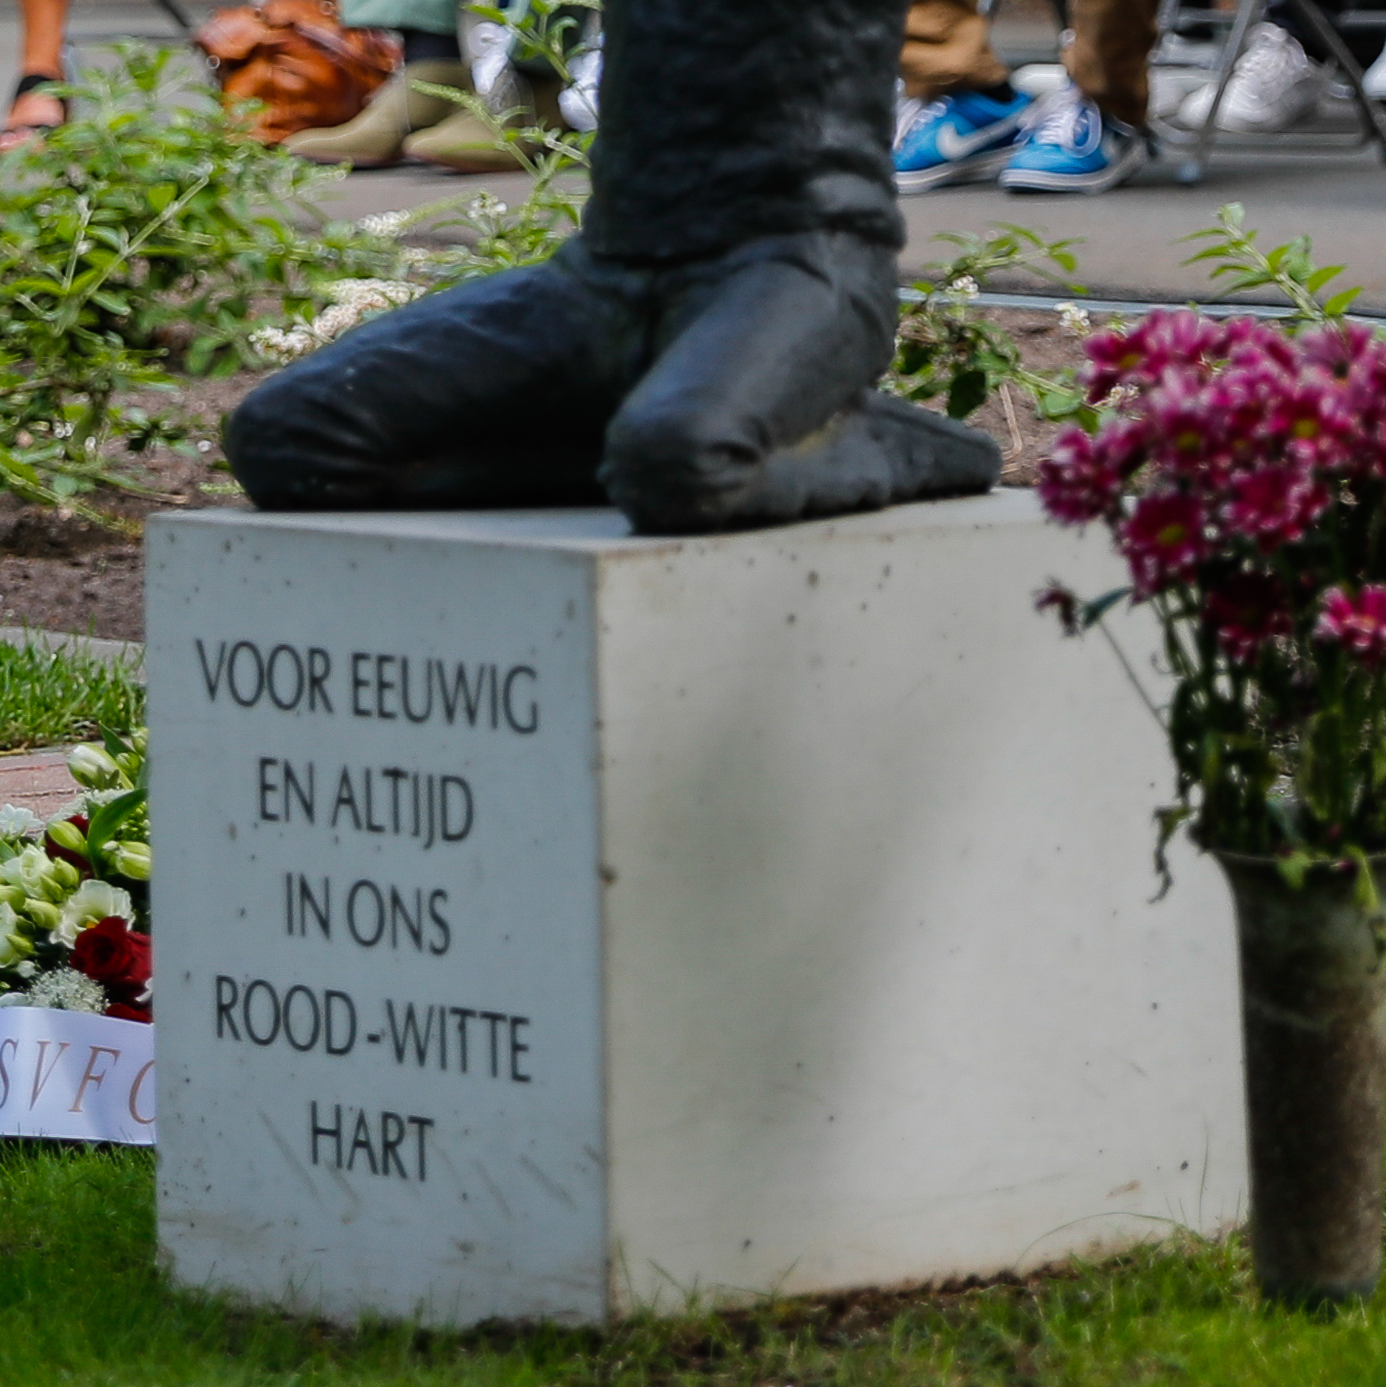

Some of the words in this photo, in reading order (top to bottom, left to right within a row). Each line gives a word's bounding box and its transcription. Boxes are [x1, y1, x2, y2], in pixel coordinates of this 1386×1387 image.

[196, 638, 333, 713] VOOR
[352, 652, 538, 734] EEUWIG
[259, 757, 314, 825] EN
[331, 765, 474, 850] ALTIJD
[286, 872, 331, 941] IN
[346, 879, 451, 956] ONS
[216, 975, 531, 1083] ROOD-WITTE
[311, 1100, 435, 1182] HART
